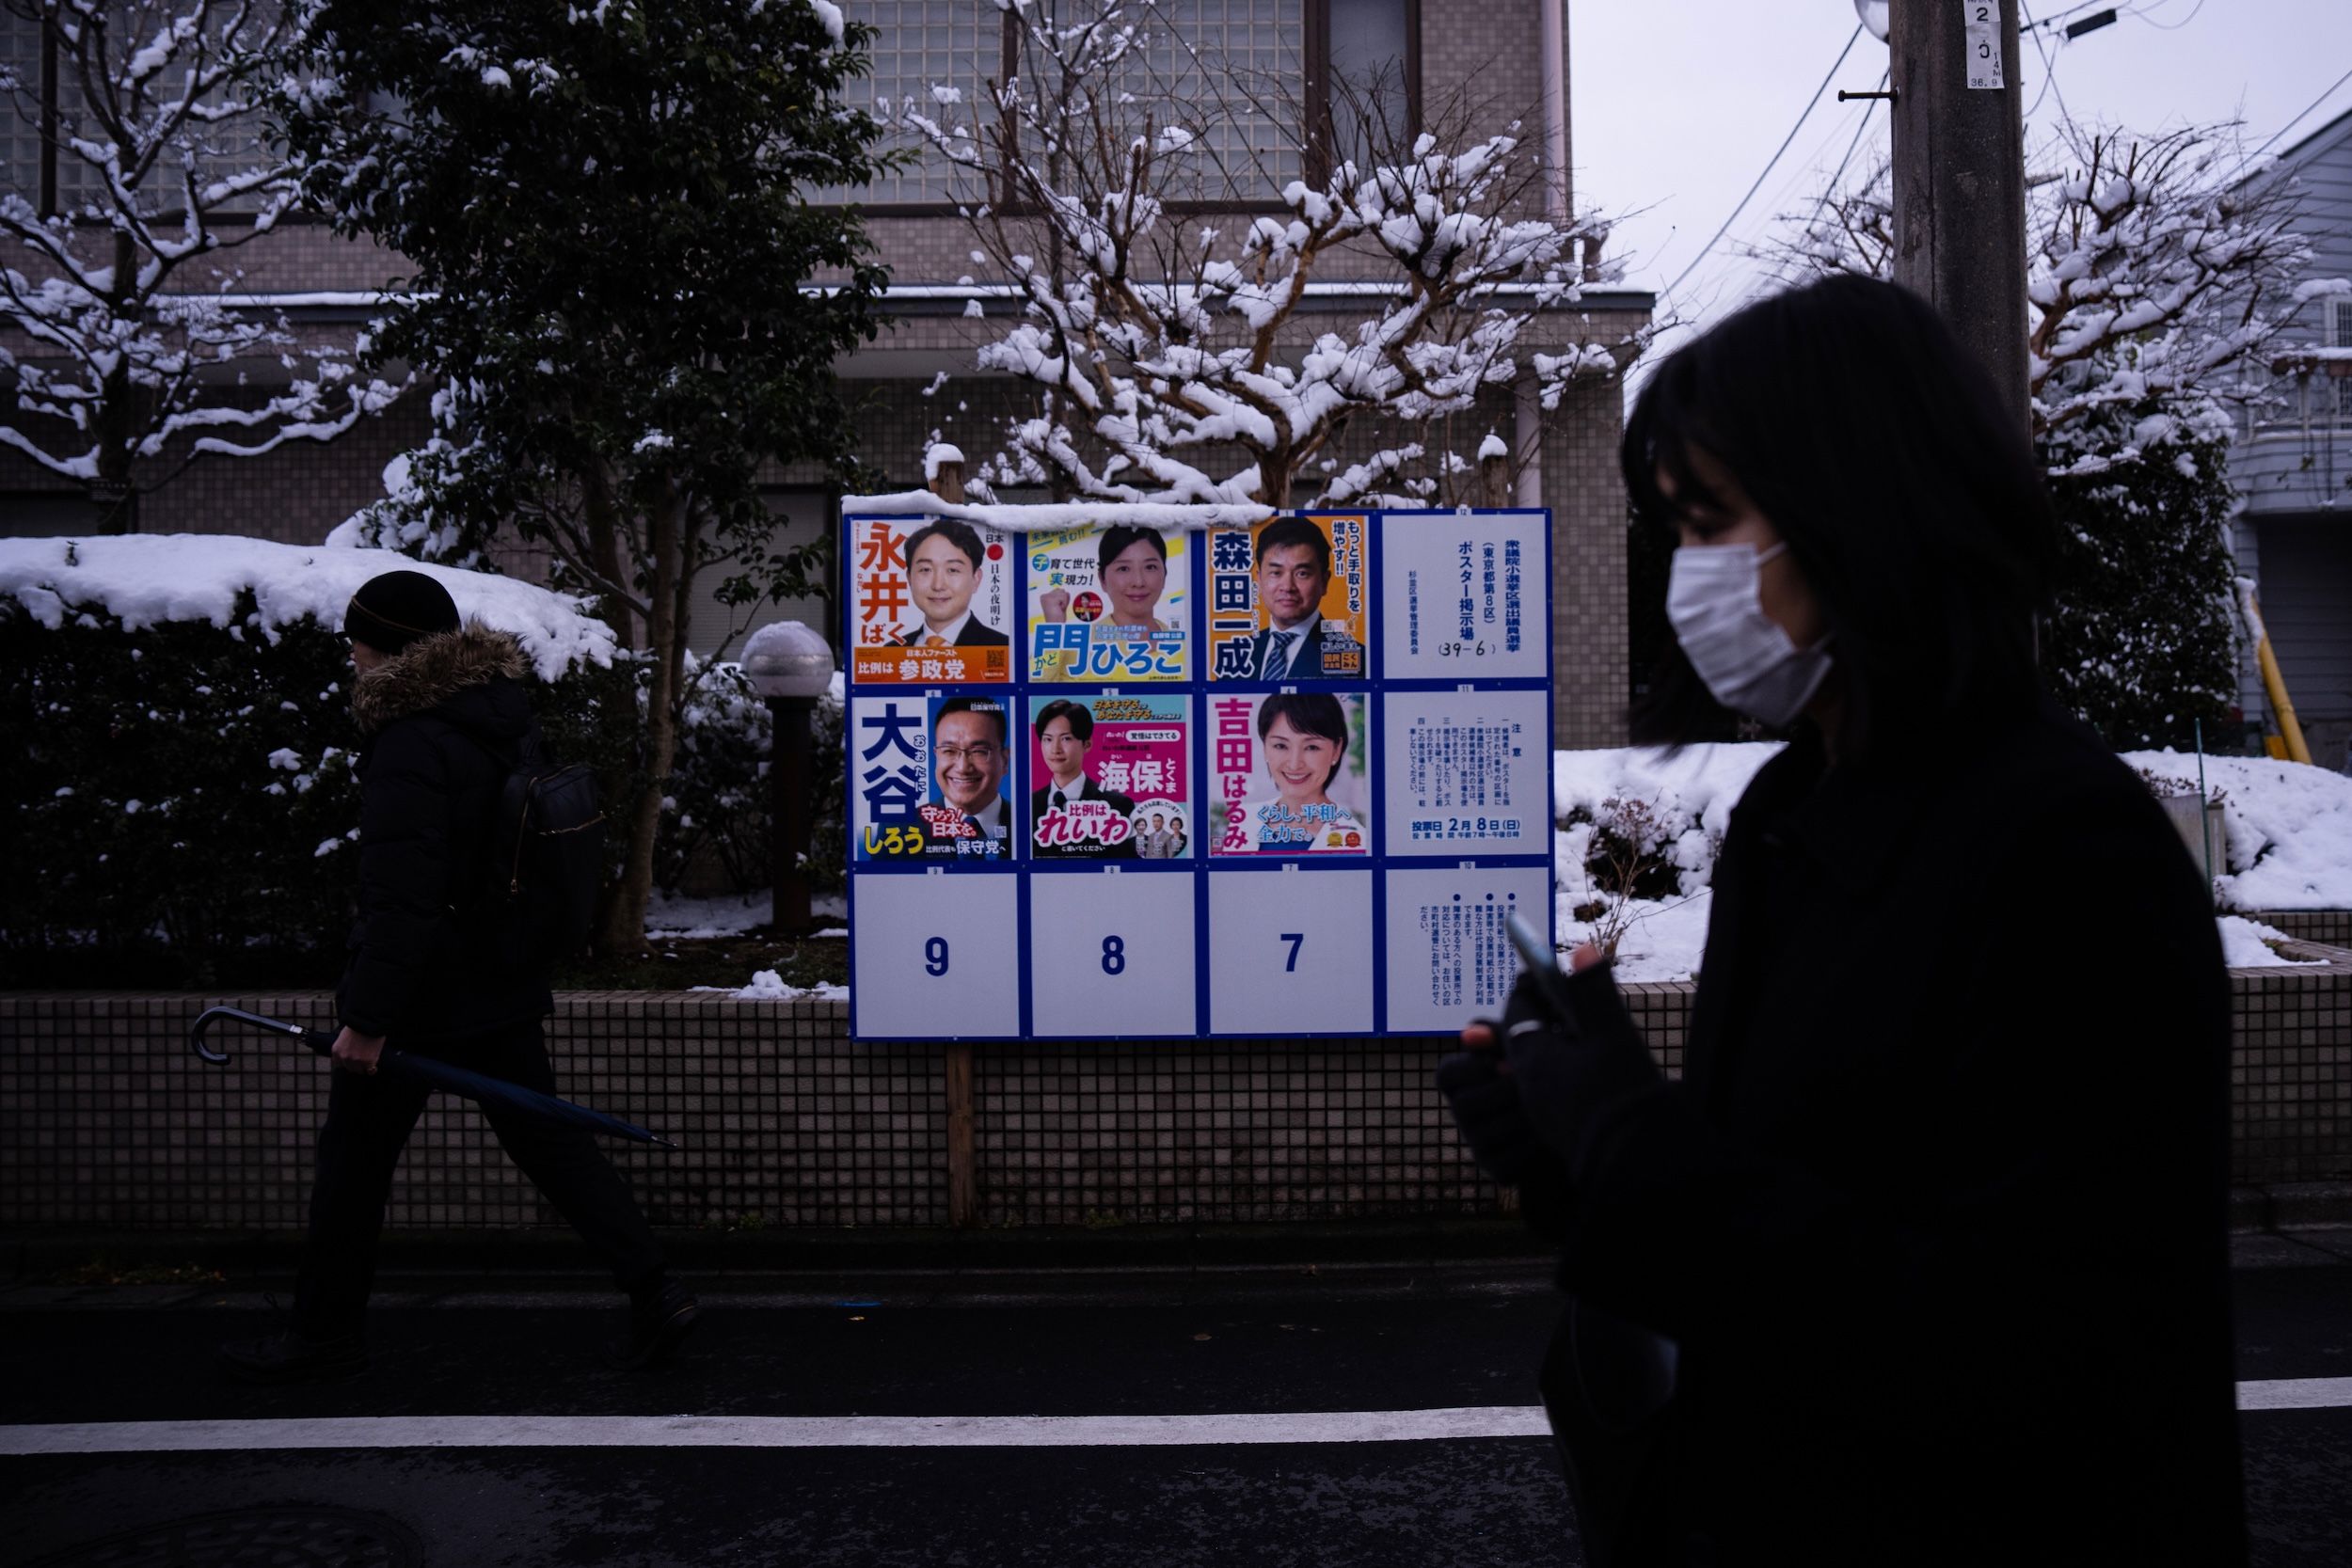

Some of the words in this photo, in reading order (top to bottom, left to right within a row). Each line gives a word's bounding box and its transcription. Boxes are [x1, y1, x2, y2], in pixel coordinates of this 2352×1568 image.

[1346, 520, 1361, 613] もっと手取りを
[990, 563, 1001, 626] 日本の夜明け
[1213, 531, 1254, 677] 森田一成
[1459, 541, 1474, 641] ポスター掲示場
[1505, 540, 1521, 653] 衆議院小選挙区選出議員選挙
[1408, 570, 1420, 655] 杉並区選挙管理委員会
[858, 661, 894, 675] 比例は
[898, 658, 965, 681] 参政党
[906, 648, 958, 657] 日本人ファースト
[862, 704, 923, 823] 大谷
[1097, 759, 1165, 793] 海保
[1165, 757, 1177, 795] とくま
[1215, 698, 1253, 850] 吉田はるみ
[1038, 810, 1129, 844] れいわ
[1070, 804, 1107, 816] 比例は
[865, 826, 925, 856] しろう
[926, 936, 949, 976] 9
[1102, 935, 1125, 974] 8
[1280, 933, 1305, 972] 7
